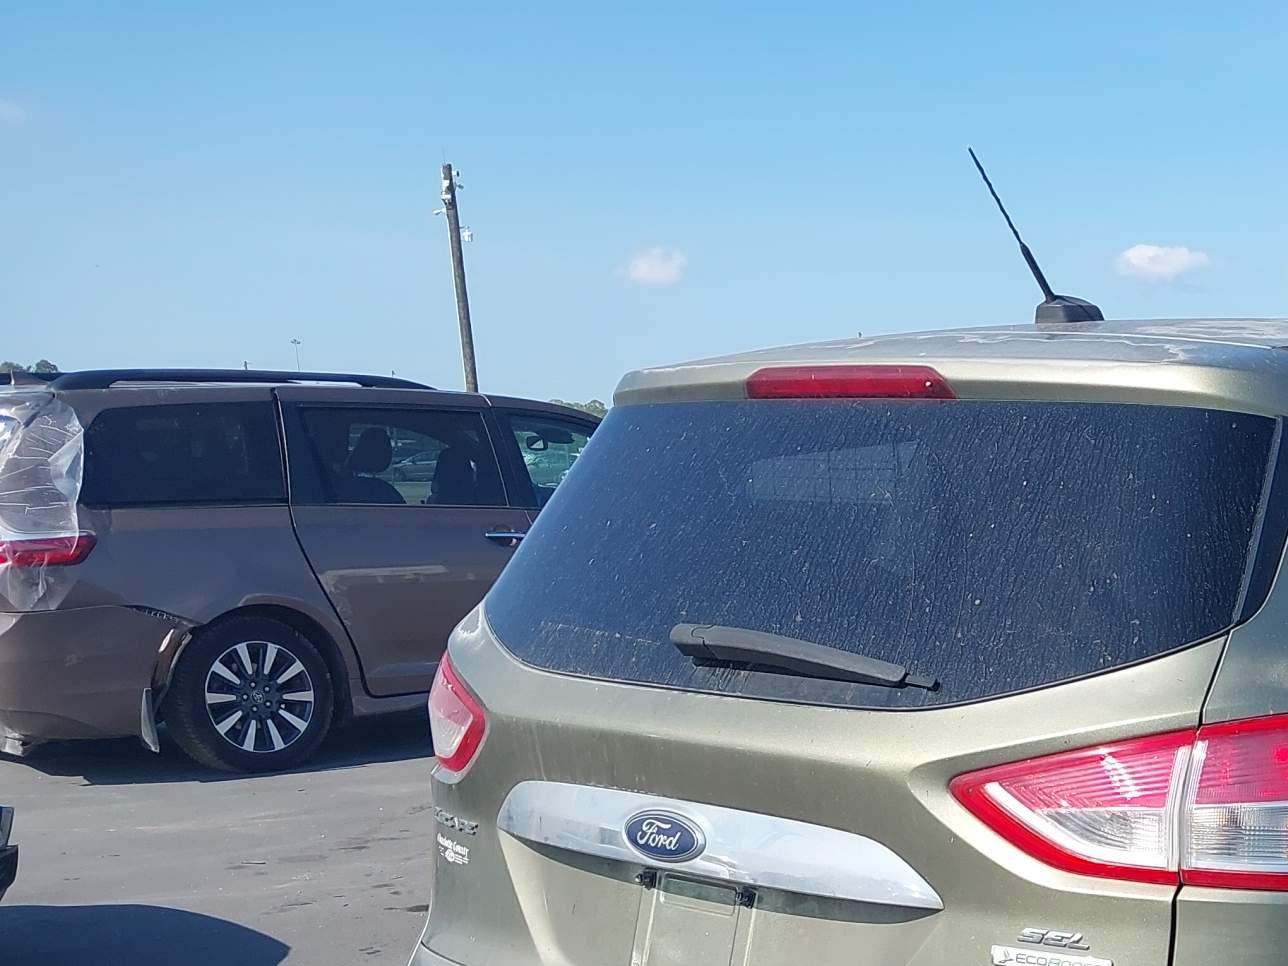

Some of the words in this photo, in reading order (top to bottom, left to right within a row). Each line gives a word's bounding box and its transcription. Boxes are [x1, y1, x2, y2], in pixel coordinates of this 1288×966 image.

[433, 806, 479, 835] SCAPE
[637, 819, 681, 850] Ford
[1017, 927, 1090, 951] SEL
